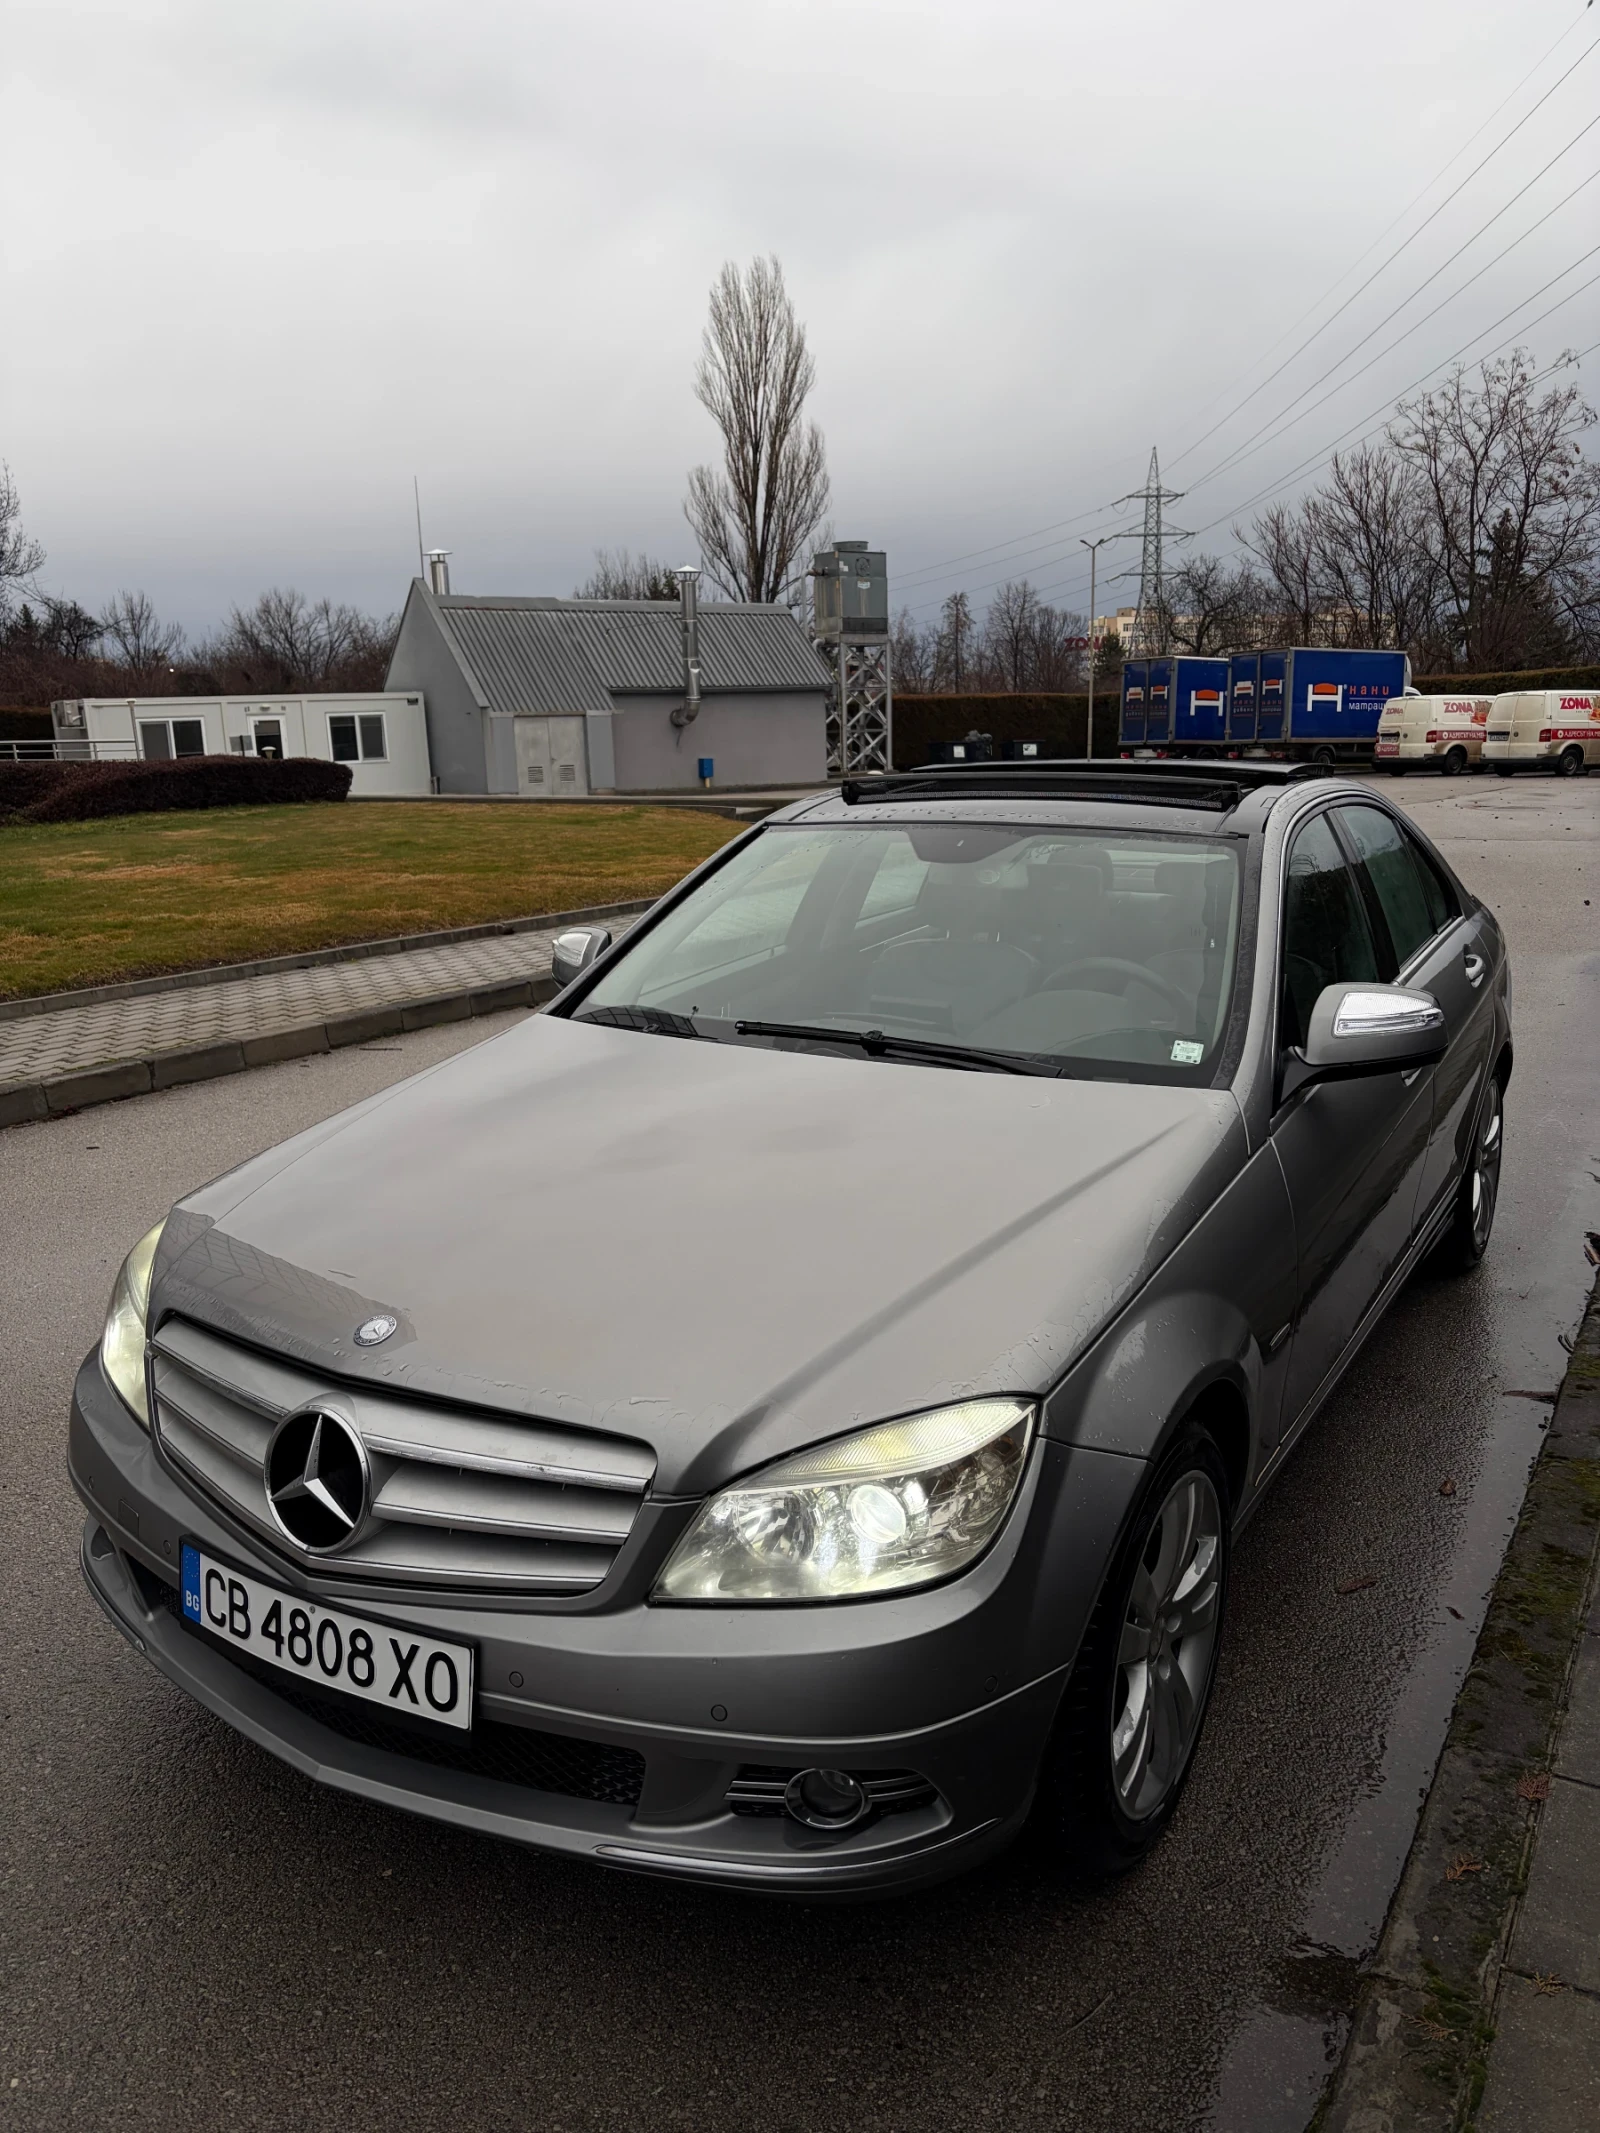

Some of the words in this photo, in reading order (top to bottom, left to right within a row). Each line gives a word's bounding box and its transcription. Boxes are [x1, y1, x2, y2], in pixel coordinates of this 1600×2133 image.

[1443, 702, 1474, 713] ZONA
[1559, 697, 1592, 709] ZONA
[1385, 707, 1403, 715] ZONA
[185, 1590, 200, 1612] BG
[206, 1568, 251, 1640] CB
[261, 1599, 375, 1687] 4808
[388, 1637, 458, 1713] XO
